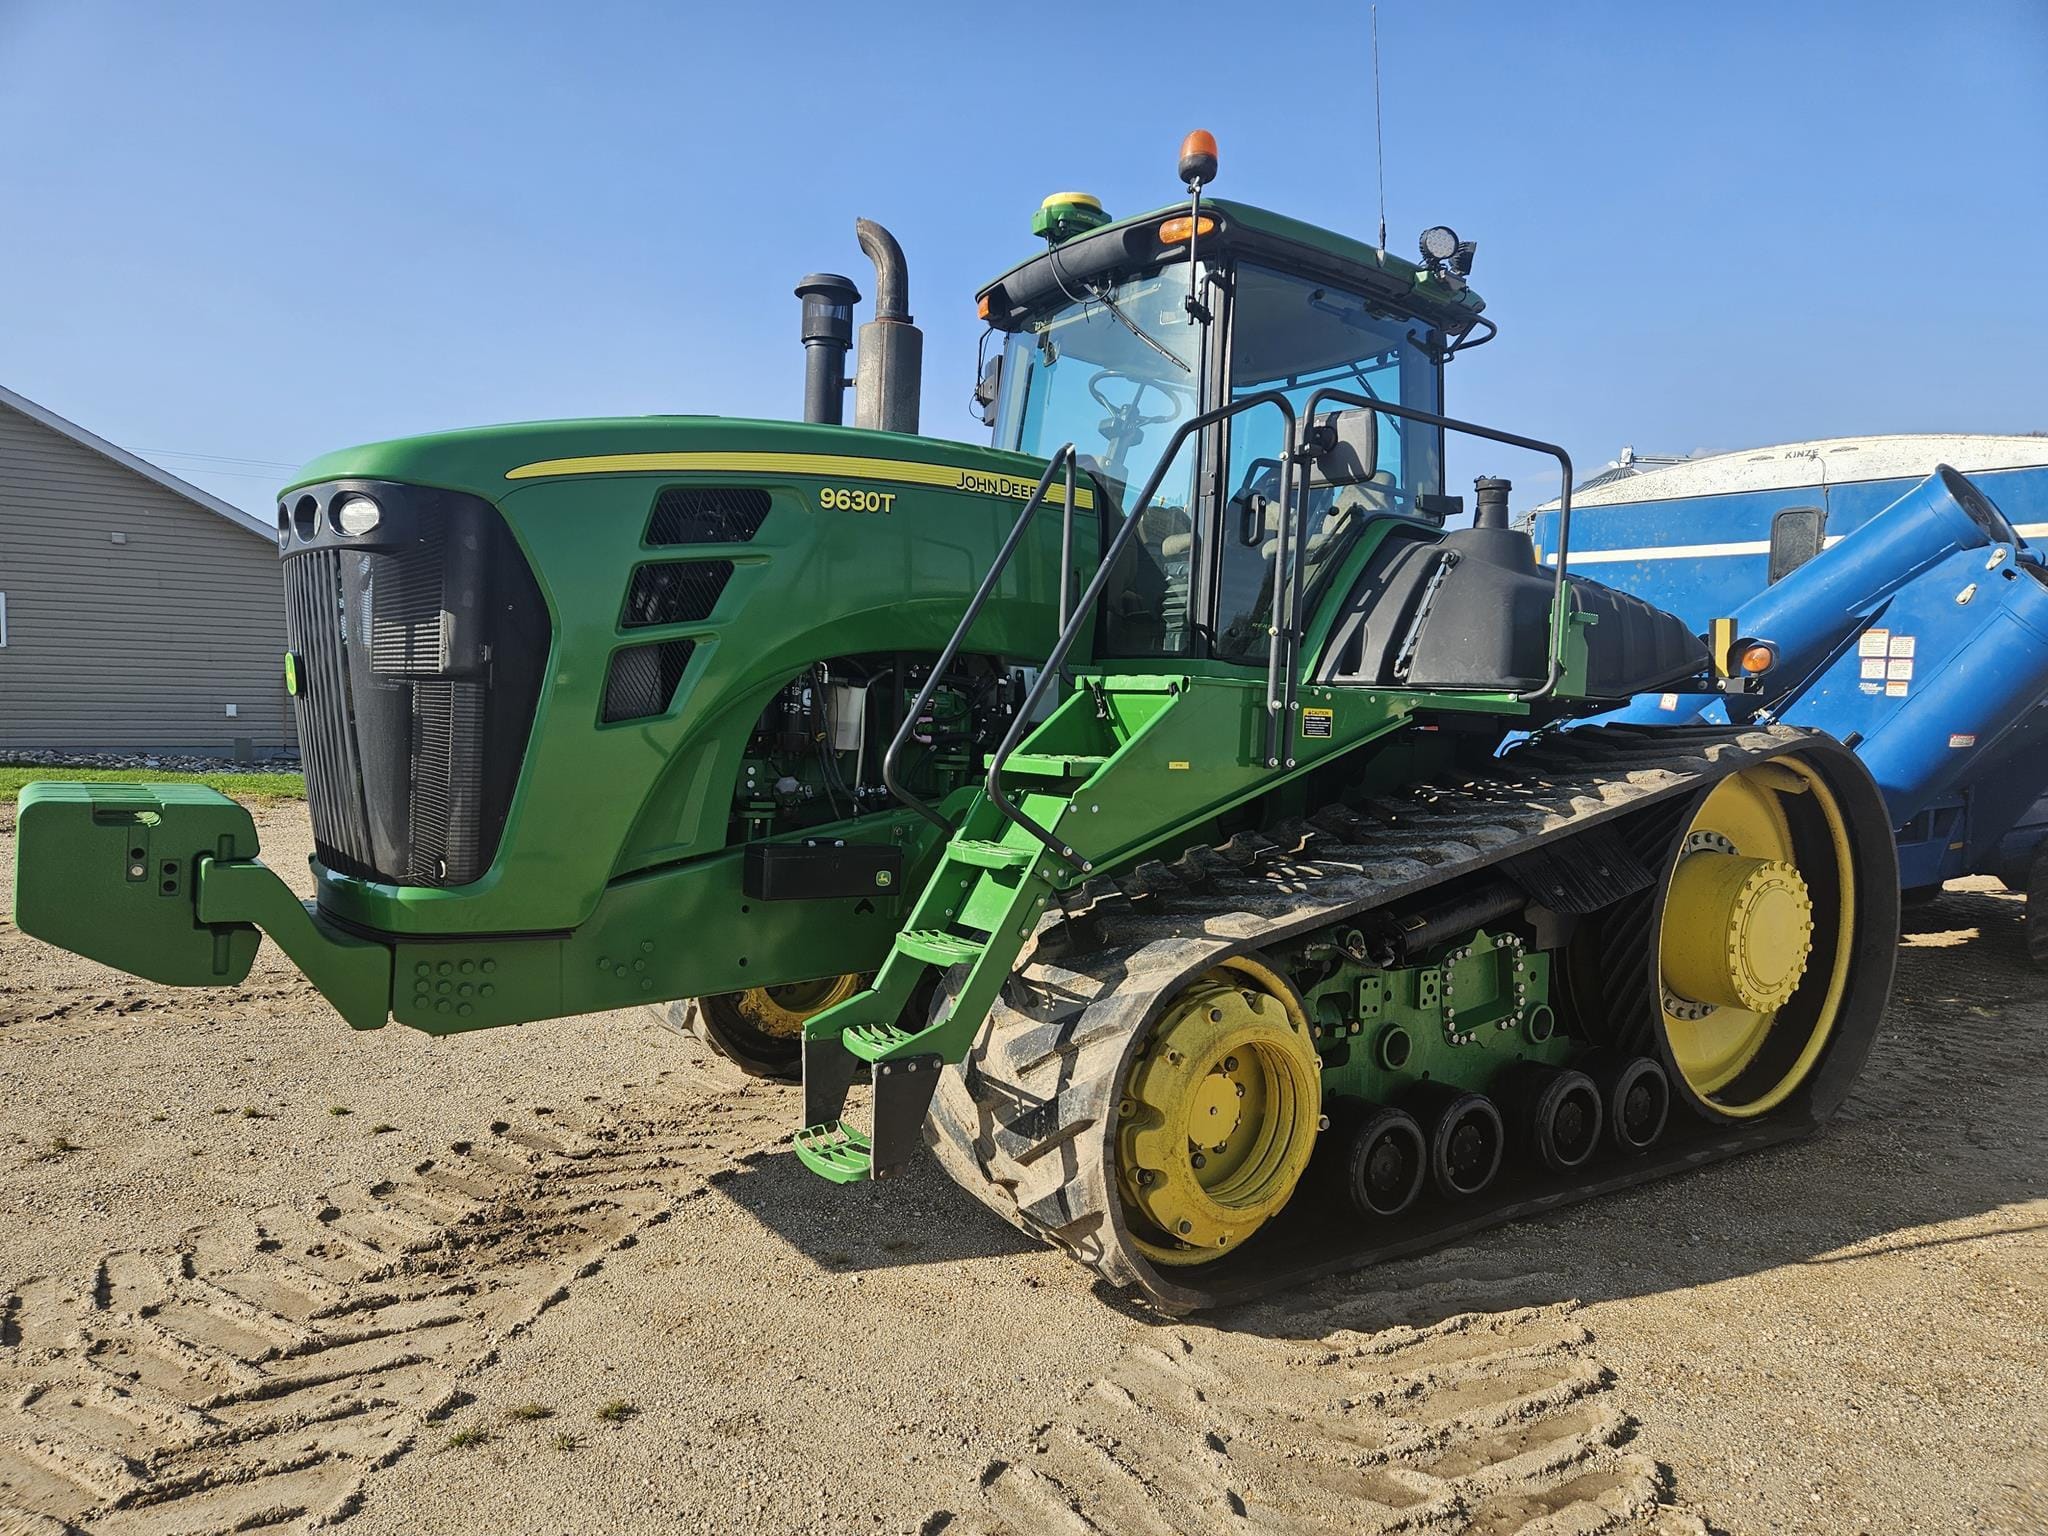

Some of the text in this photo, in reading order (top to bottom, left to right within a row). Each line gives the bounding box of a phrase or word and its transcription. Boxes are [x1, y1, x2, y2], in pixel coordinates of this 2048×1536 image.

[1784, 448, 1819, 460] KINZE
[820, 487, 896, 513] 9630T
[956, 472, 1047, 502] JOHN DEER
